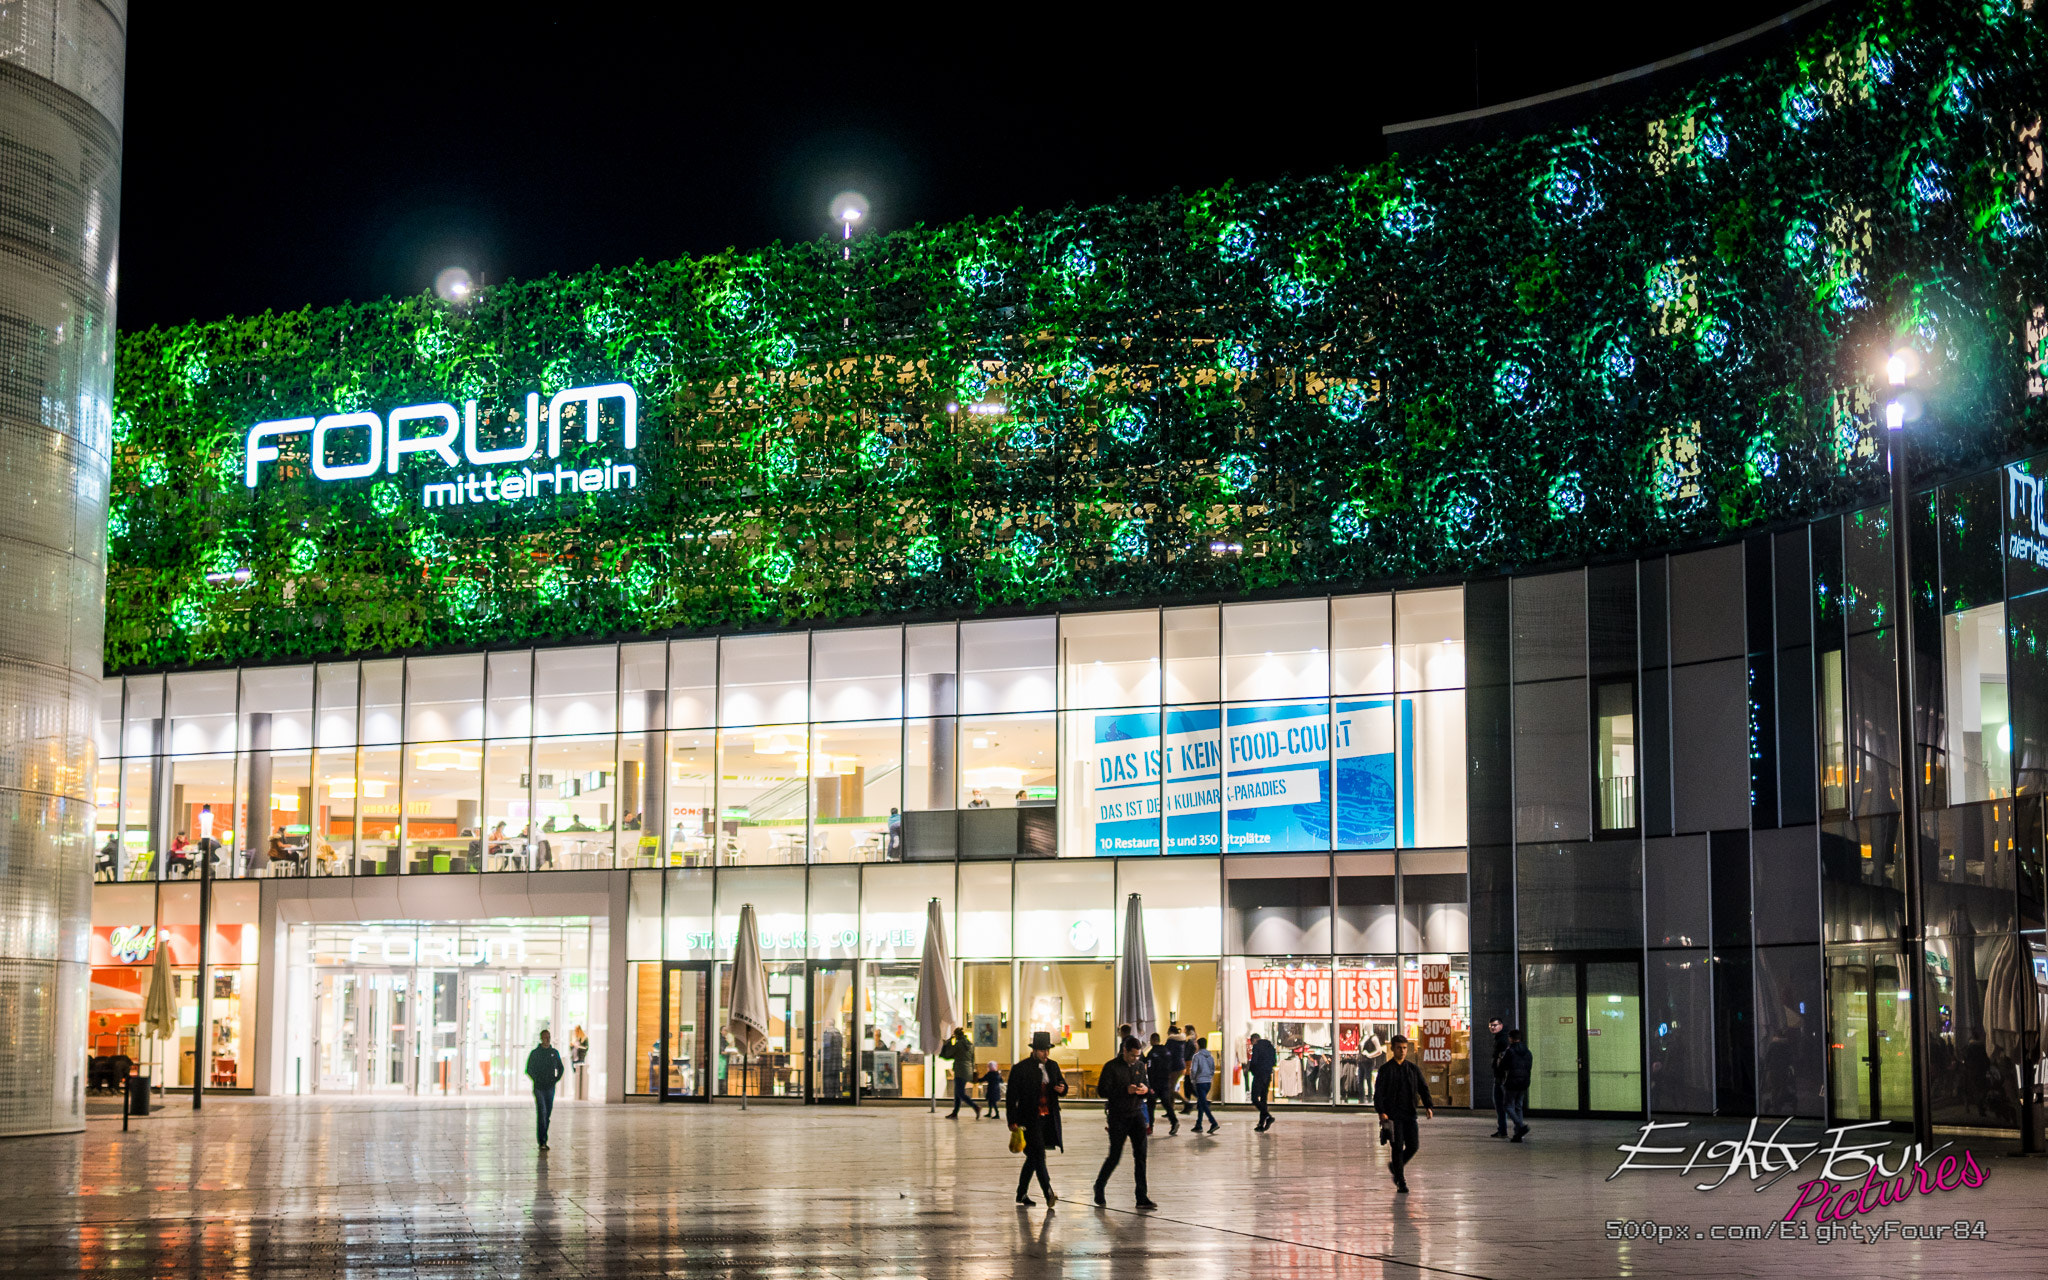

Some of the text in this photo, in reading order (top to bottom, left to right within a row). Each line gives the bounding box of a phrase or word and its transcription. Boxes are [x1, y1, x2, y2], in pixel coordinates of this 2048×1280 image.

[245, 381, 638, 488] FORUM
[422, 460, 638, 507] mittelrhein
[1100, 753, 1138, 783] DAS
[1144, 747, 1173, 777] IST
[1181, 739, 1221, 772] KEIN
[1100, 803, 1123, 820] DAS
[1126, 800, 1143, 817] IST
[1174, 778, 1287, 811] KULINARK-PARADIES
[1100, 832, 1271, 849] 10 Restaurats und 350 itzplätze
[686, 927, 917, 950] STARUCKS COFFEE
[350, 935, 526, 963] FORUM
[1422, 964, 1449, 980] 30%
[1252, 979, 1288, 1009] WIR
[1293, 979, 1398, 1010] SCHIESSEN
[1427, 981, 1445, 993] AUF
[1423, 993, 1450, 1006] ALLES
[1423, 1020, 1451, 1035] 30%
[1428, 1036, 1446, 1049] AUF
[1423, 1049, 1451, 1062] ALLES
